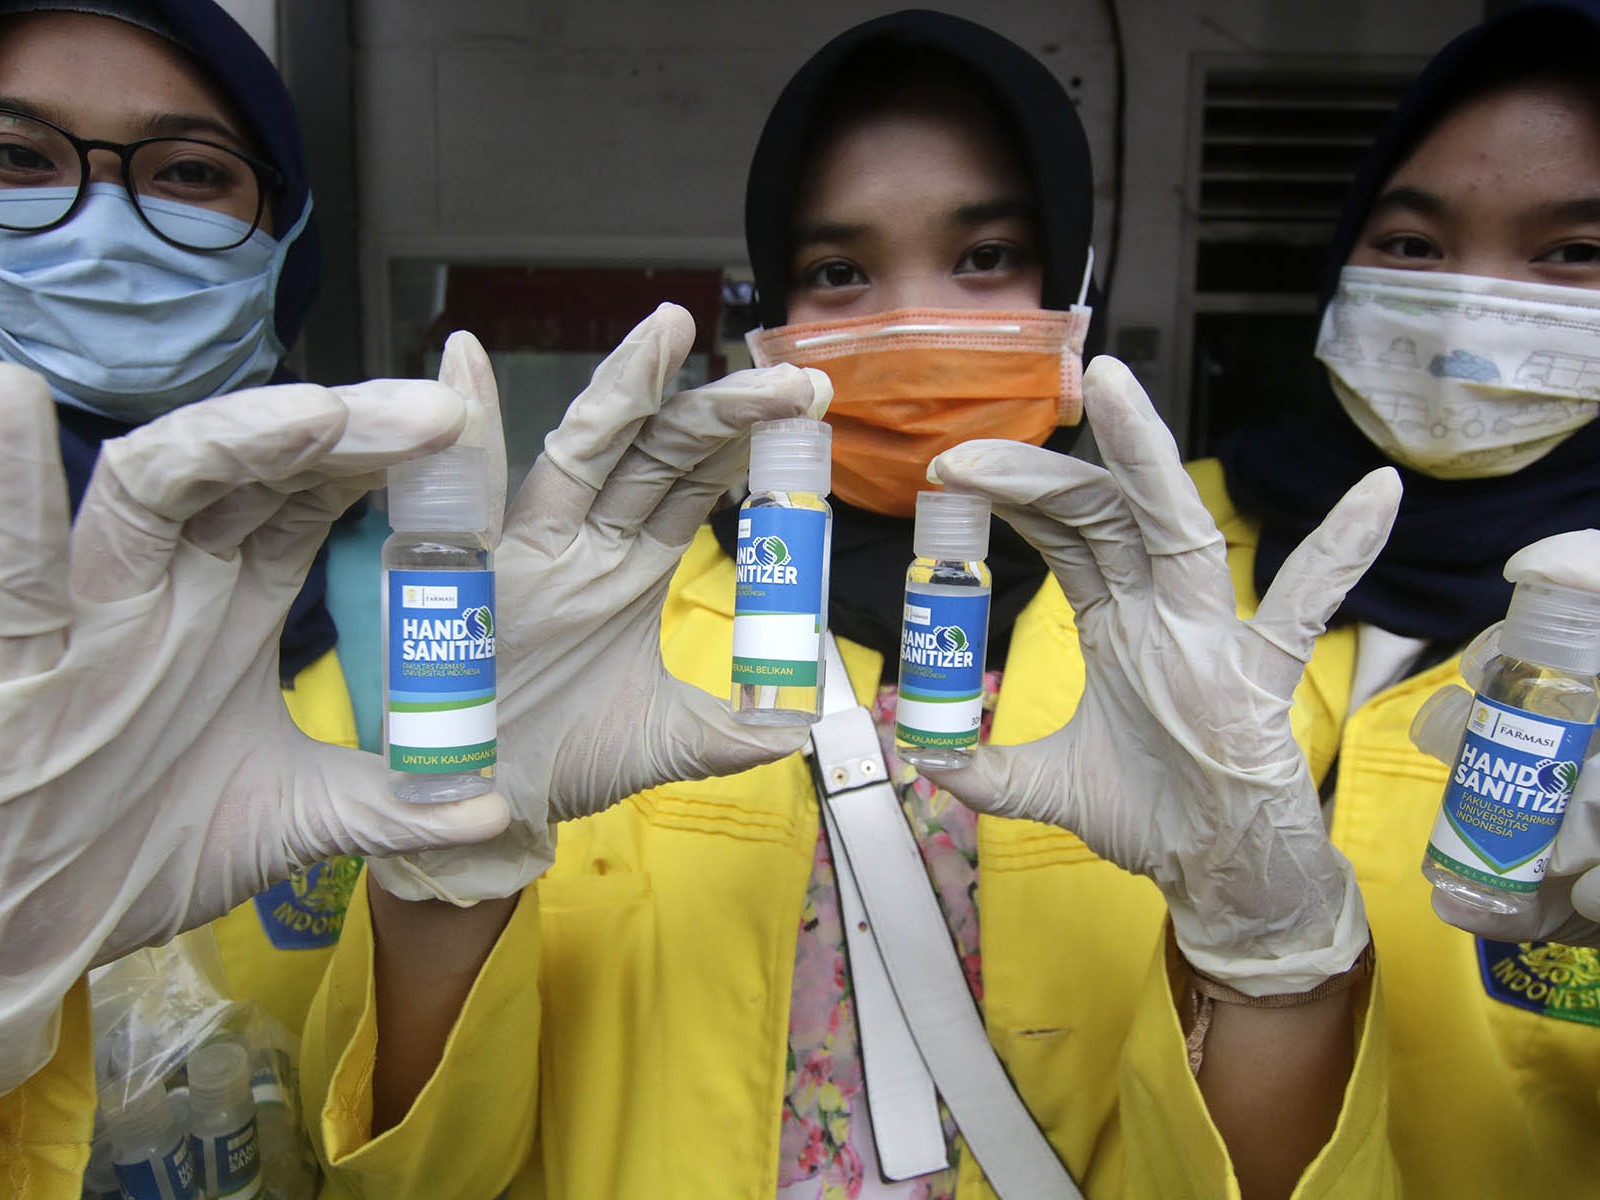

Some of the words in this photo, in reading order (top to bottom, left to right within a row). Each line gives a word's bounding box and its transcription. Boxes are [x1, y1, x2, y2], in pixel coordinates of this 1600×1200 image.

[403, 619, 467, 640] HAND
[756, 665, 794, 676] BELIKAN
[1500, 726, 1555, 748] FARMASI
[402, 754, 438, 765] UNTUK
[440, 751, 490, 764] KALANGAN
[1462, 743, 1539, 787] HAND
[1454, 766, 1569, 814] SANITIZE
[1460, 802, 1529, 832] UNIVERSITAS
[1462, 792, 1514, 818] FAKULTAS
[1456, 811, 1514, 838] INDONESIA
